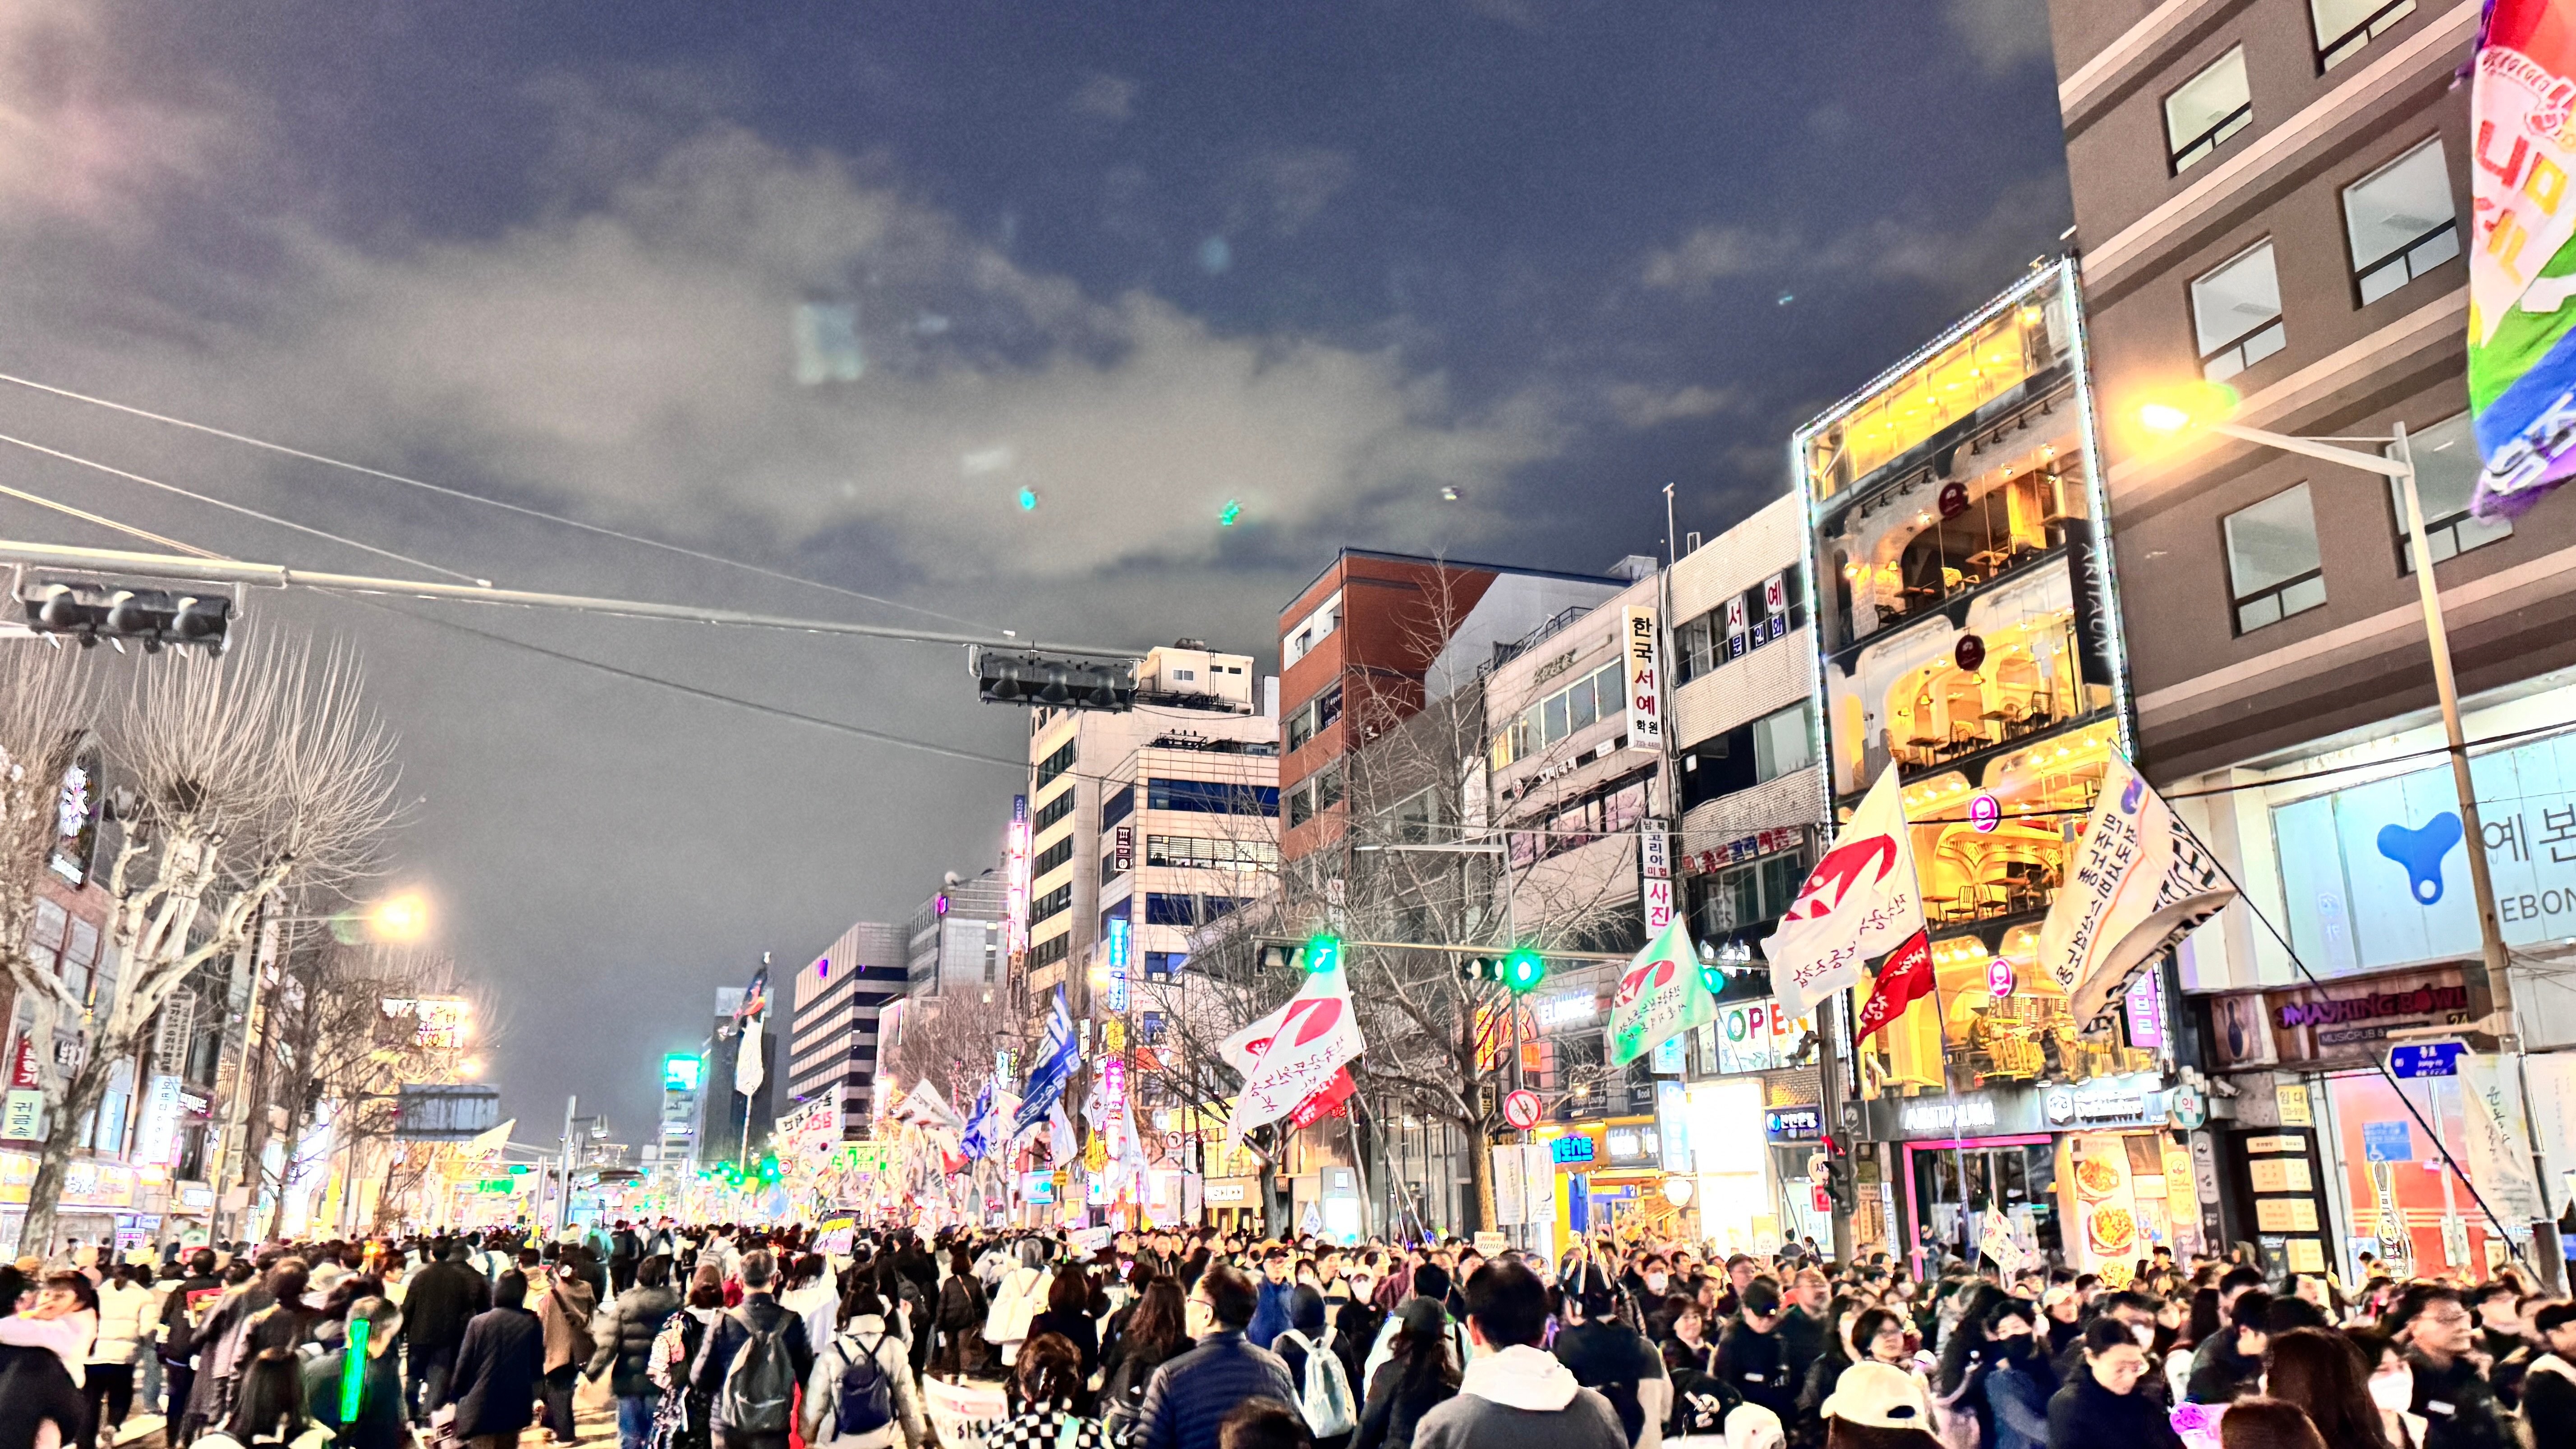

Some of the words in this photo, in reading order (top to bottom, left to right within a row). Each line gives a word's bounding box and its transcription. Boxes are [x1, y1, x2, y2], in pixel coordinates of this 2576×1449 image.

[2081, 542, 2109, 656] ARITAUM
[1636, 720, 1658, 735] 학원
[1649, 834, 1663, 866] 코리아
[1650, 883, 1670, 927] 사진
[2274, 993, 2398, 1029] SMASHING
[2399, 984, 2468, 1014] BOWL
[2182, 1097, 2194, 1113] 약
[2280, 1090, 2304, 1104] 임대
[9, 1102, 33, 1137] 귀금속
